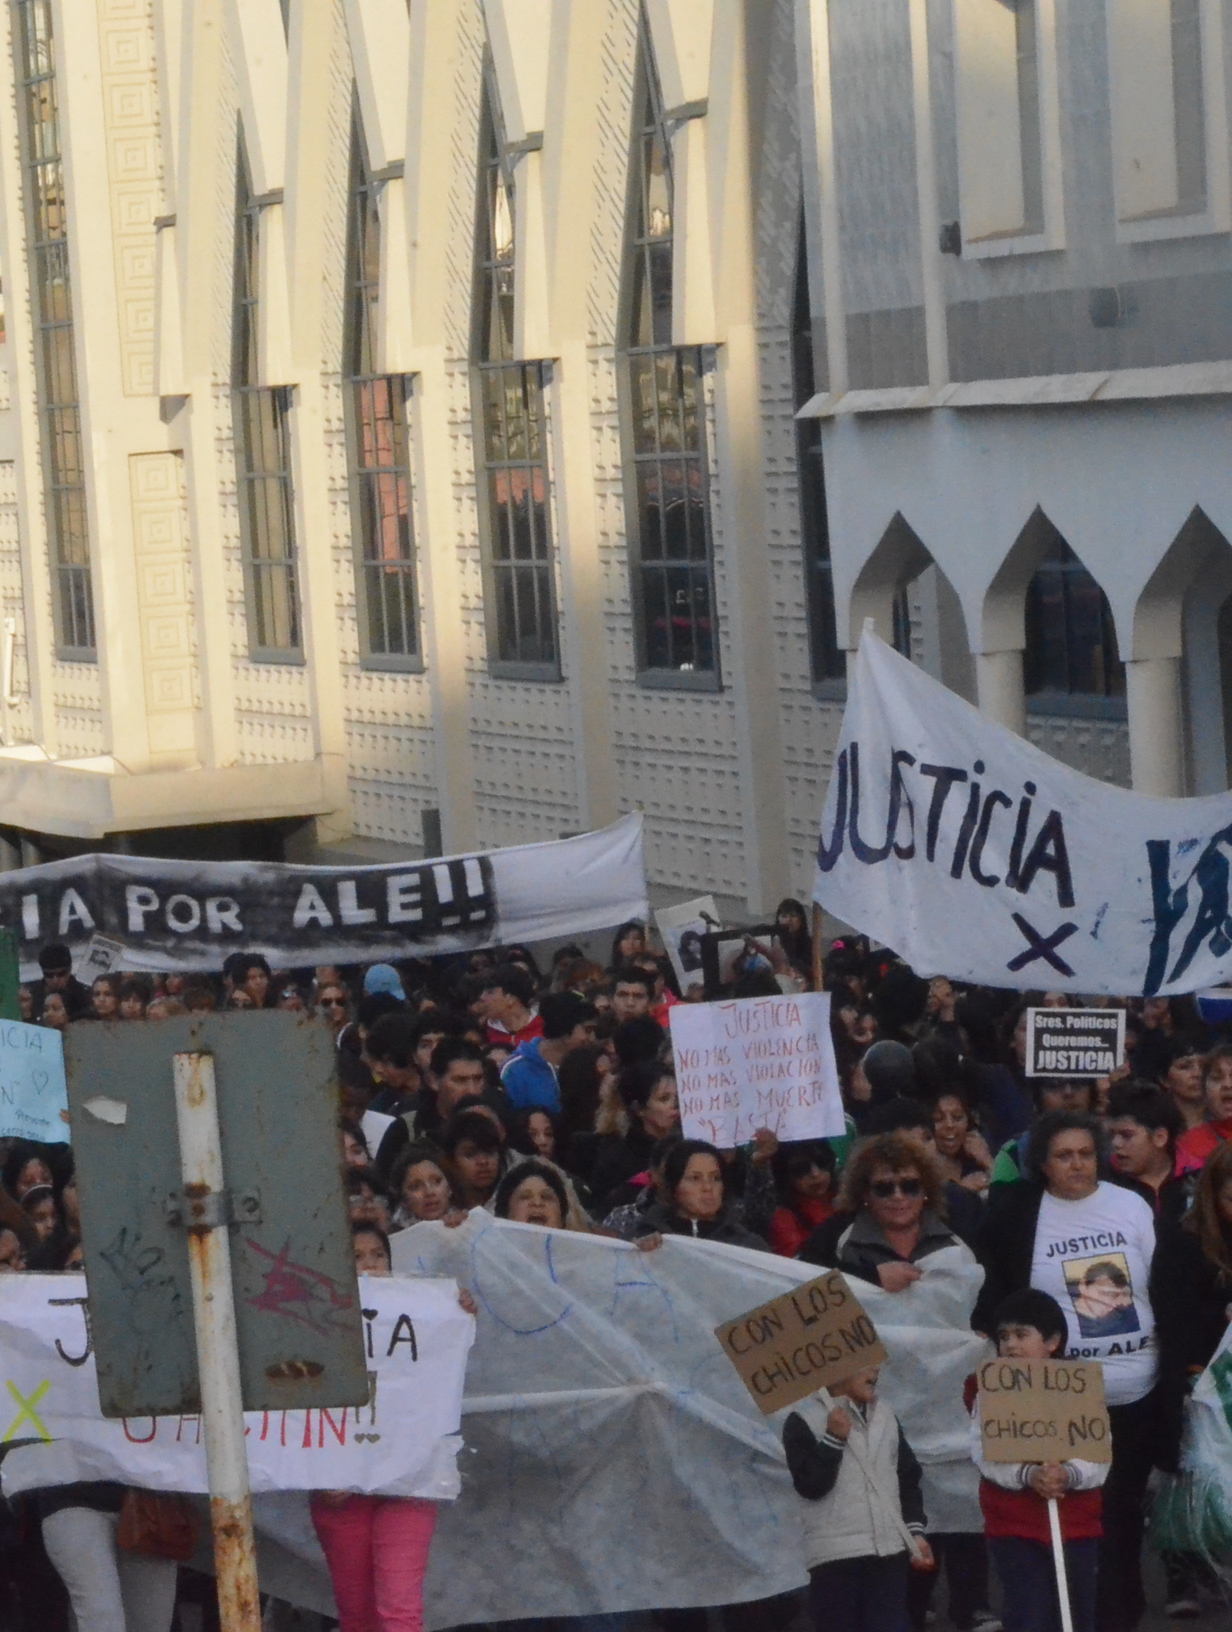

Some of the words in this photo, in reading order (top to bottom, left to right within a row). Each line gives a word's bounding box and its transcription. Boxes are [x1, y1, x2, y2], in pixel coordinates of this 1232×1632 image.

[126, 885, 243, 933] POR
[1007, 912, 1079, 978] X
[720, 1001, 802, 1039] JUSTICIA
[1035, 1015, 1065, 1028] Sres.
[678, 1048, 700, 1073] NO
[742, 1033, 820, 1060] VIOLENCIA
[1036, 1050, 1116, 1071] JUSTICIA
[681, 1075, 701, 1094] NO
[745, 1057, 822, 1083] VIOLACION
[683, 1097, 703, 1117] NO
[756, 1080, 824, 1109] MUERTE
[1046, 1232, 1128, 1258] JUSTICIA
[727, 1308, 784, 1355] CON
[791, 1275, 846, 1327] LOS
[838, 1315, 877, 1353] NO
[980, 1362, 1033, 1393] CON
[1043, 1366, 1087, 1394] LOS
[1067, 1414, 1106, 1447] NO
